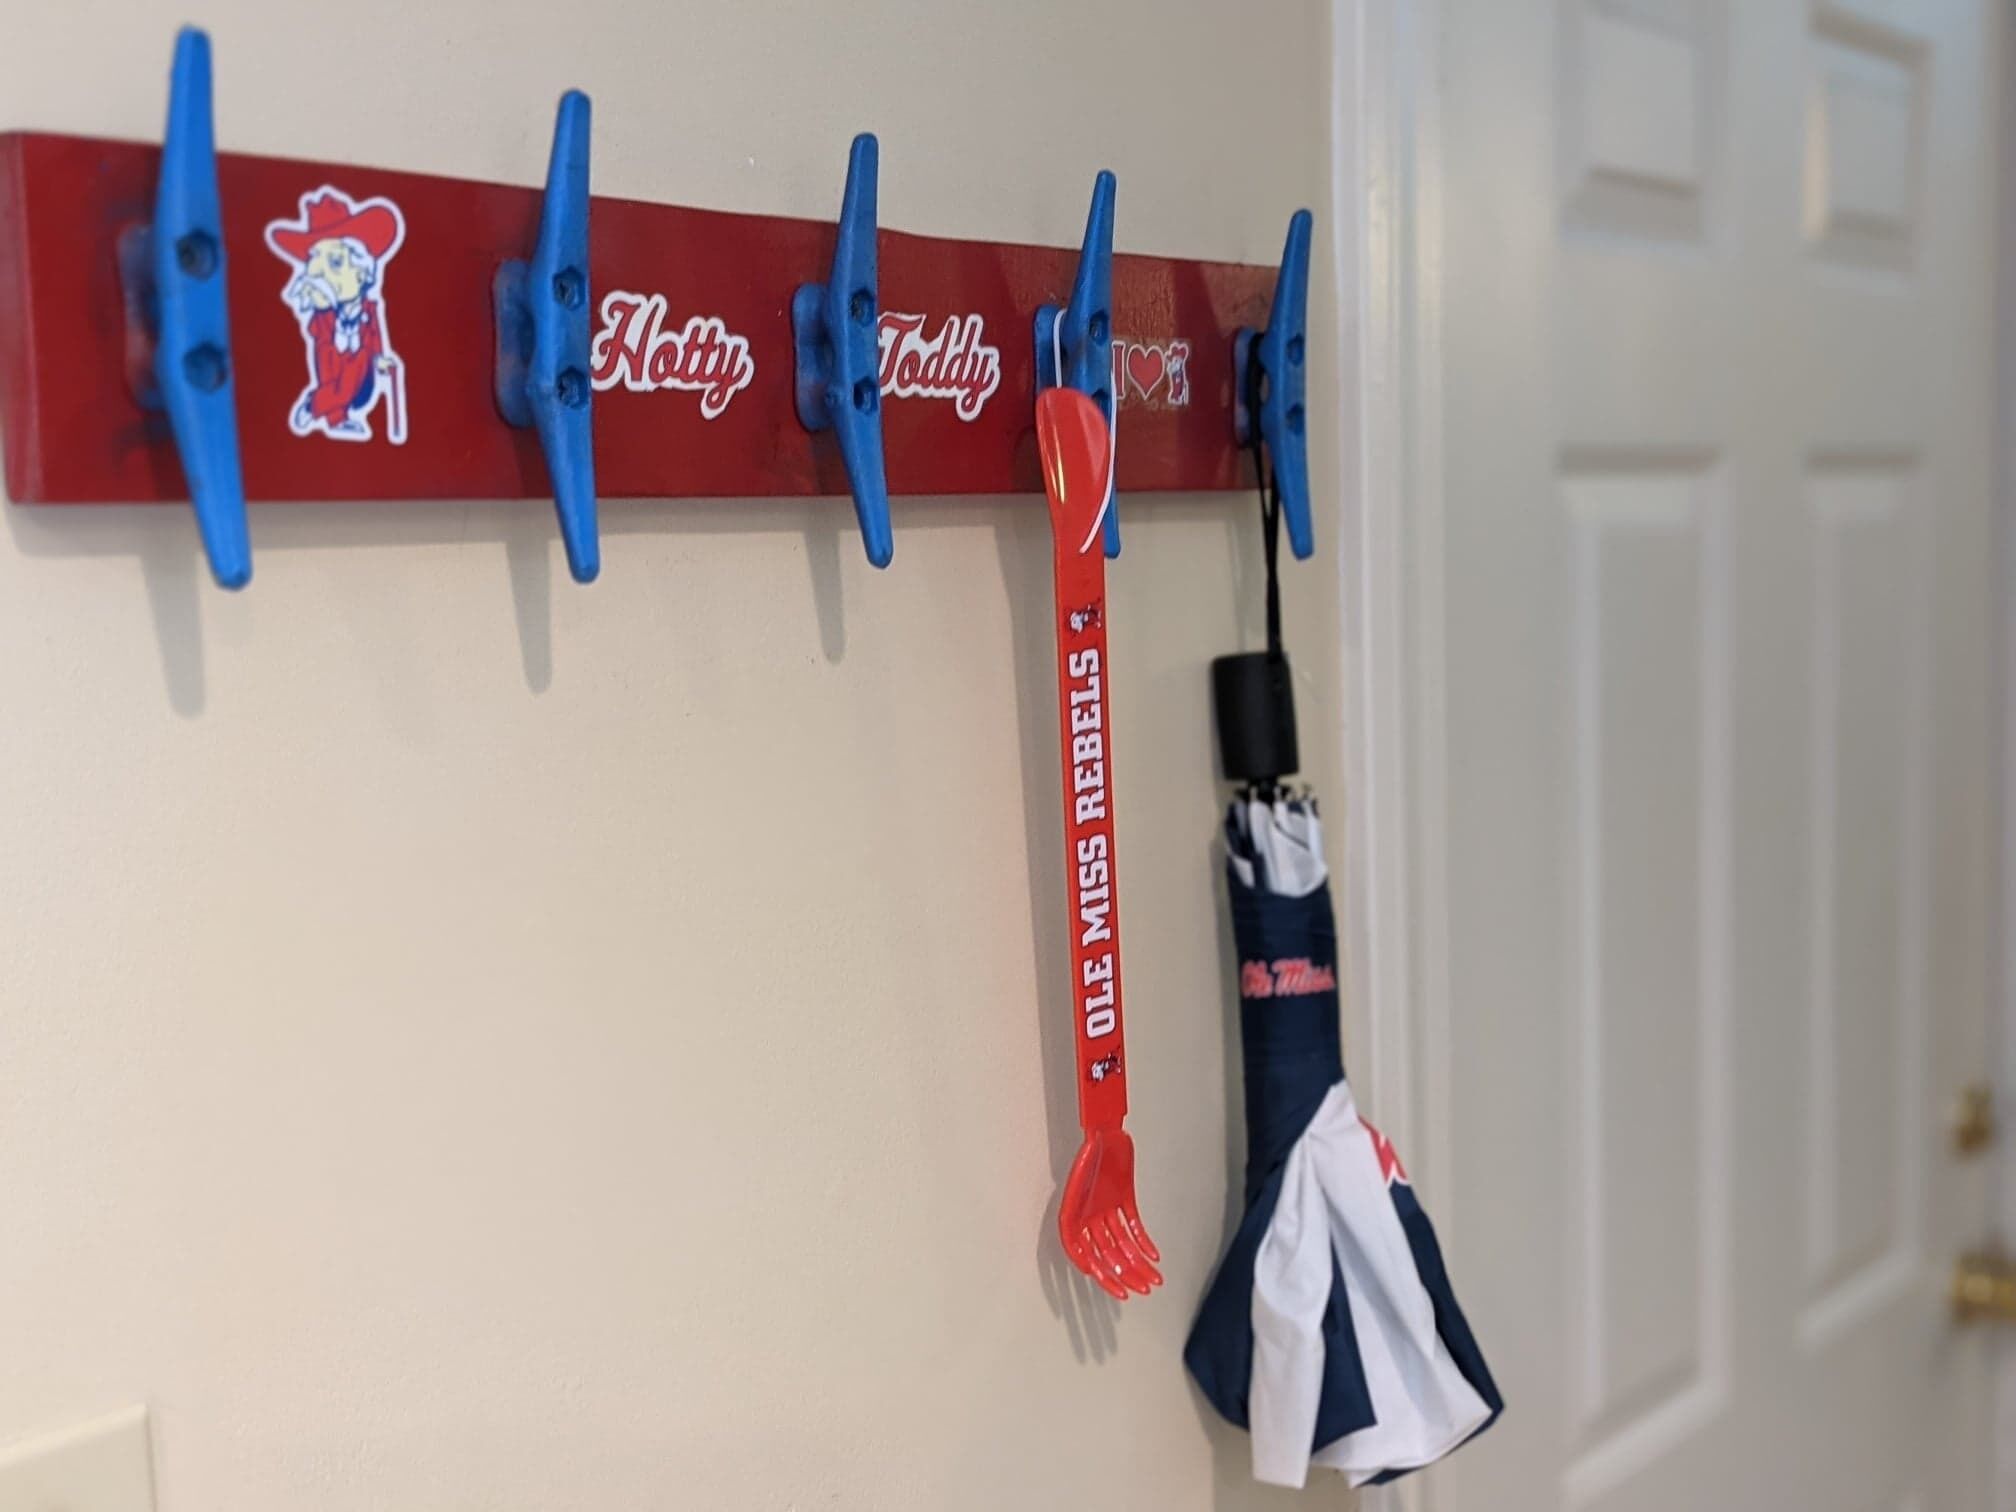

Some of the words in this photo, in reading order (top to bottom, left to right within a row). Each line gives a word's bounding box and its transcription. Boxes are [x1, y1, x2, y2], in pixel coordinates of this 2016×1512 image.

[592, 292, 753, 418] Hotty
[879, 311, 998, 421] Toddy
[1111, 341, 1126, 399] I
[1069, 648, 1105, 825] REBELS
[1077, 834, 1111, 947] MISS
[1083, 953, 1115, 1039] OLE
